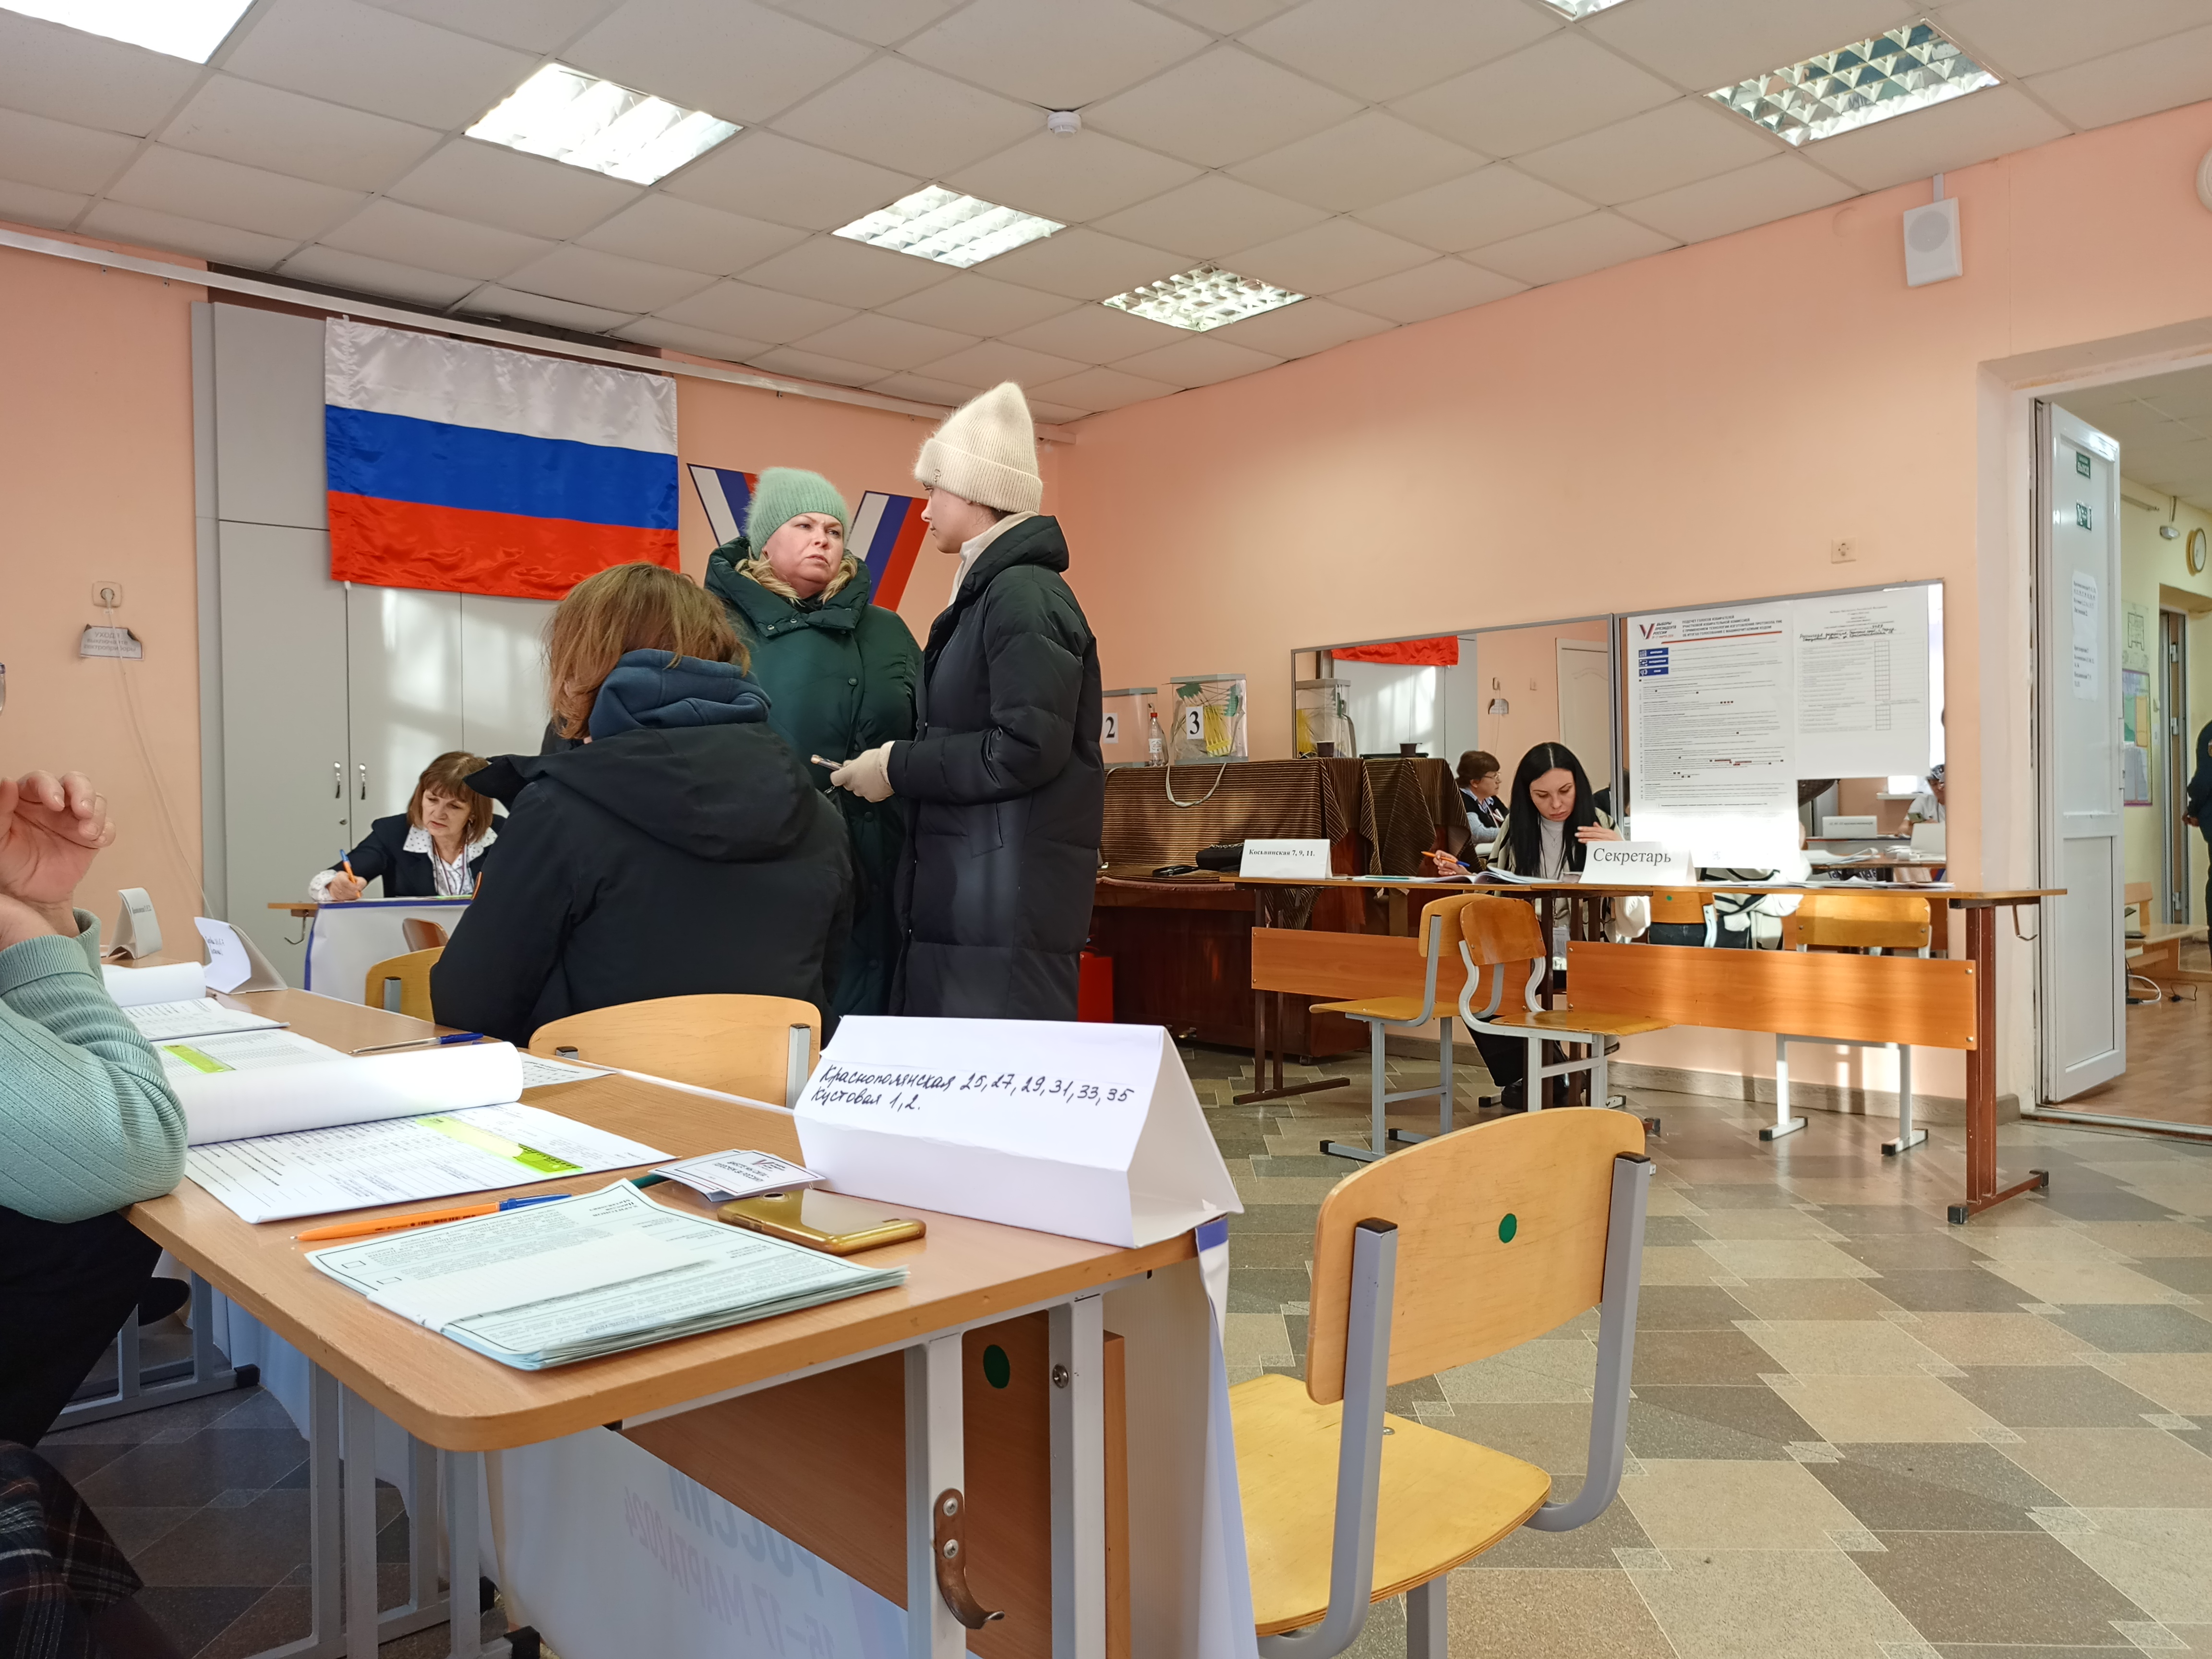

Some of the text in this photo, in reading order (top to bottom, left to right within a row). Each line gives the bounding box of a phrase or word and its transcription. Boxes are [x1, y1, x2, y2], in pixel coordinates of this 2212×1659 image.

[1106, 716, 1115, 738] 2
[1190, 711, 1200, 734] 3
[1593, 847, 1671, 866] Секретарь
[819, 1064, 956, 1092] Краснополянская
